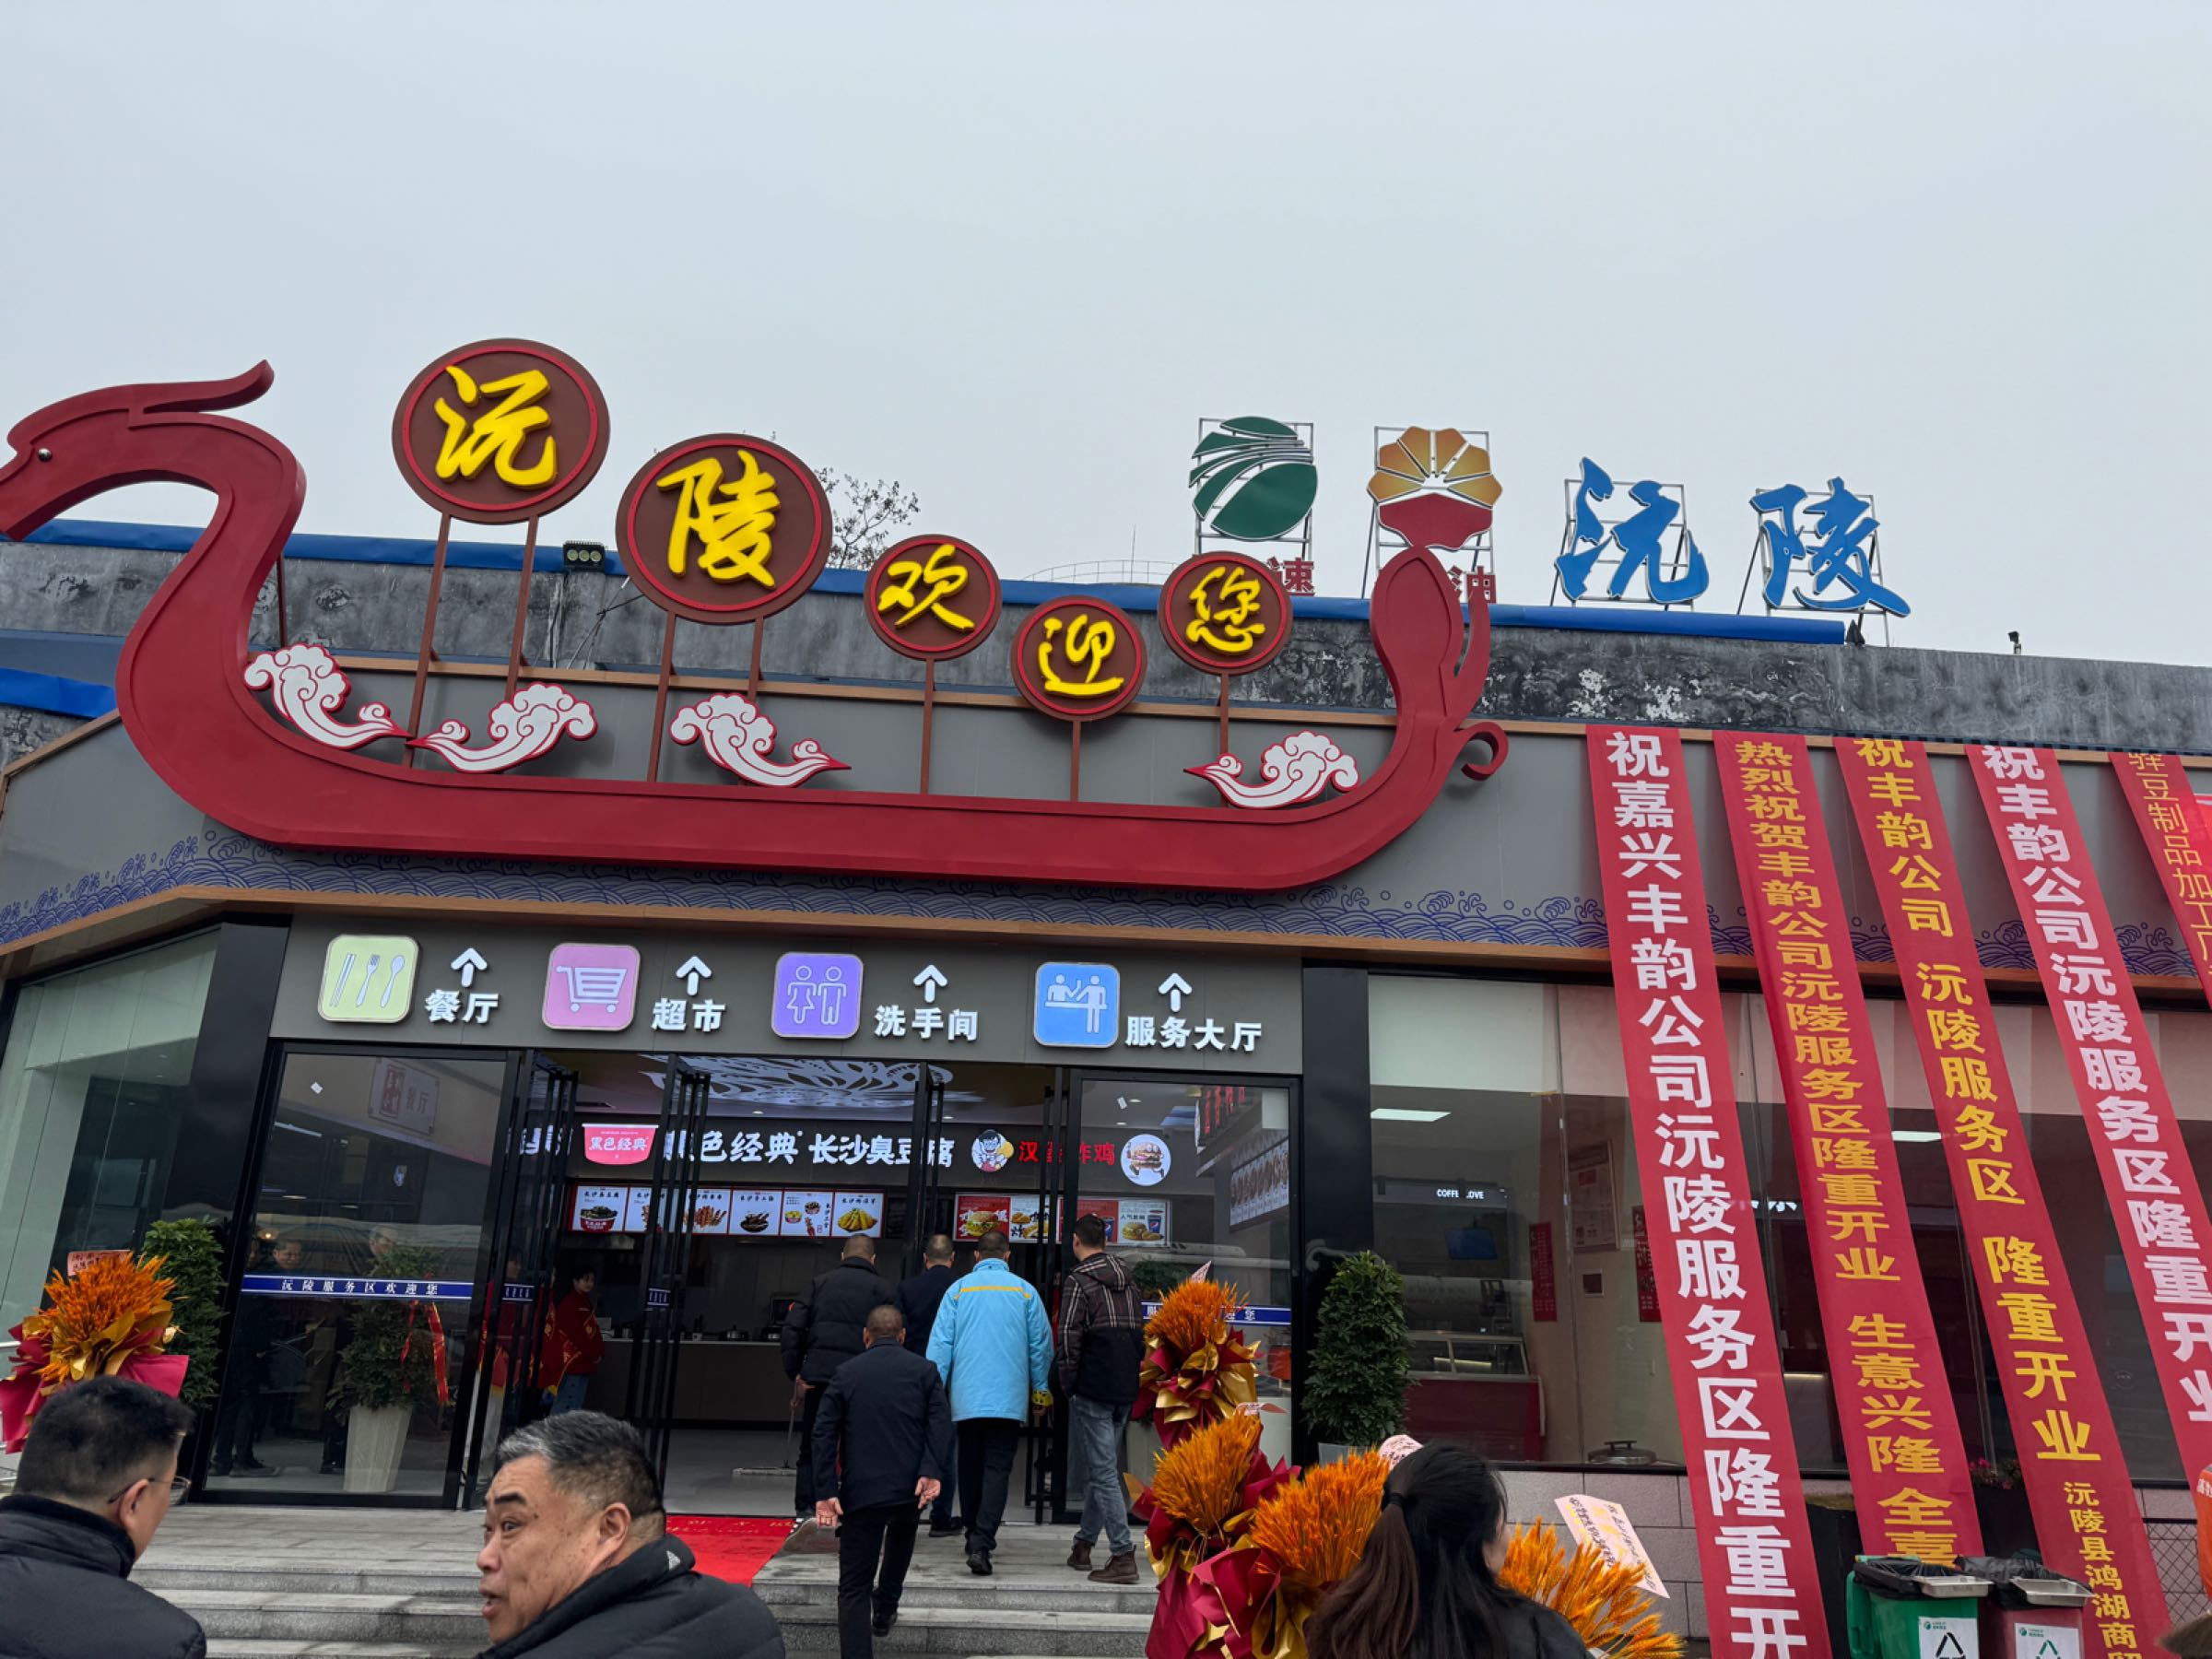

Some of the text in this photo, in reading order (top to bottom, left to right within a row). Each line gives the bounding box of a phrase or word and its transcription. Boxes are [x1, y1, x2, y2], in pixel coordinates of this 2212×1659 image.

[1554, 456, 1912, 618] 沅陵
[425, 989, 500, 1024] 餐厅
[651, 997, 726, 1032] 超市
[874, 1005, 978, 1041] 洗手间
[1124, 1016, 1263, 1052] 服务大厅
[1856, 737, 2101, 1461] 祝丰韵公司 沅陵服务区 隆重开业
[1847, 1313, 1945, 1474] 生意兴隆
[2063, 1481, 2143, 1659] 沅陵县鸿湖商
